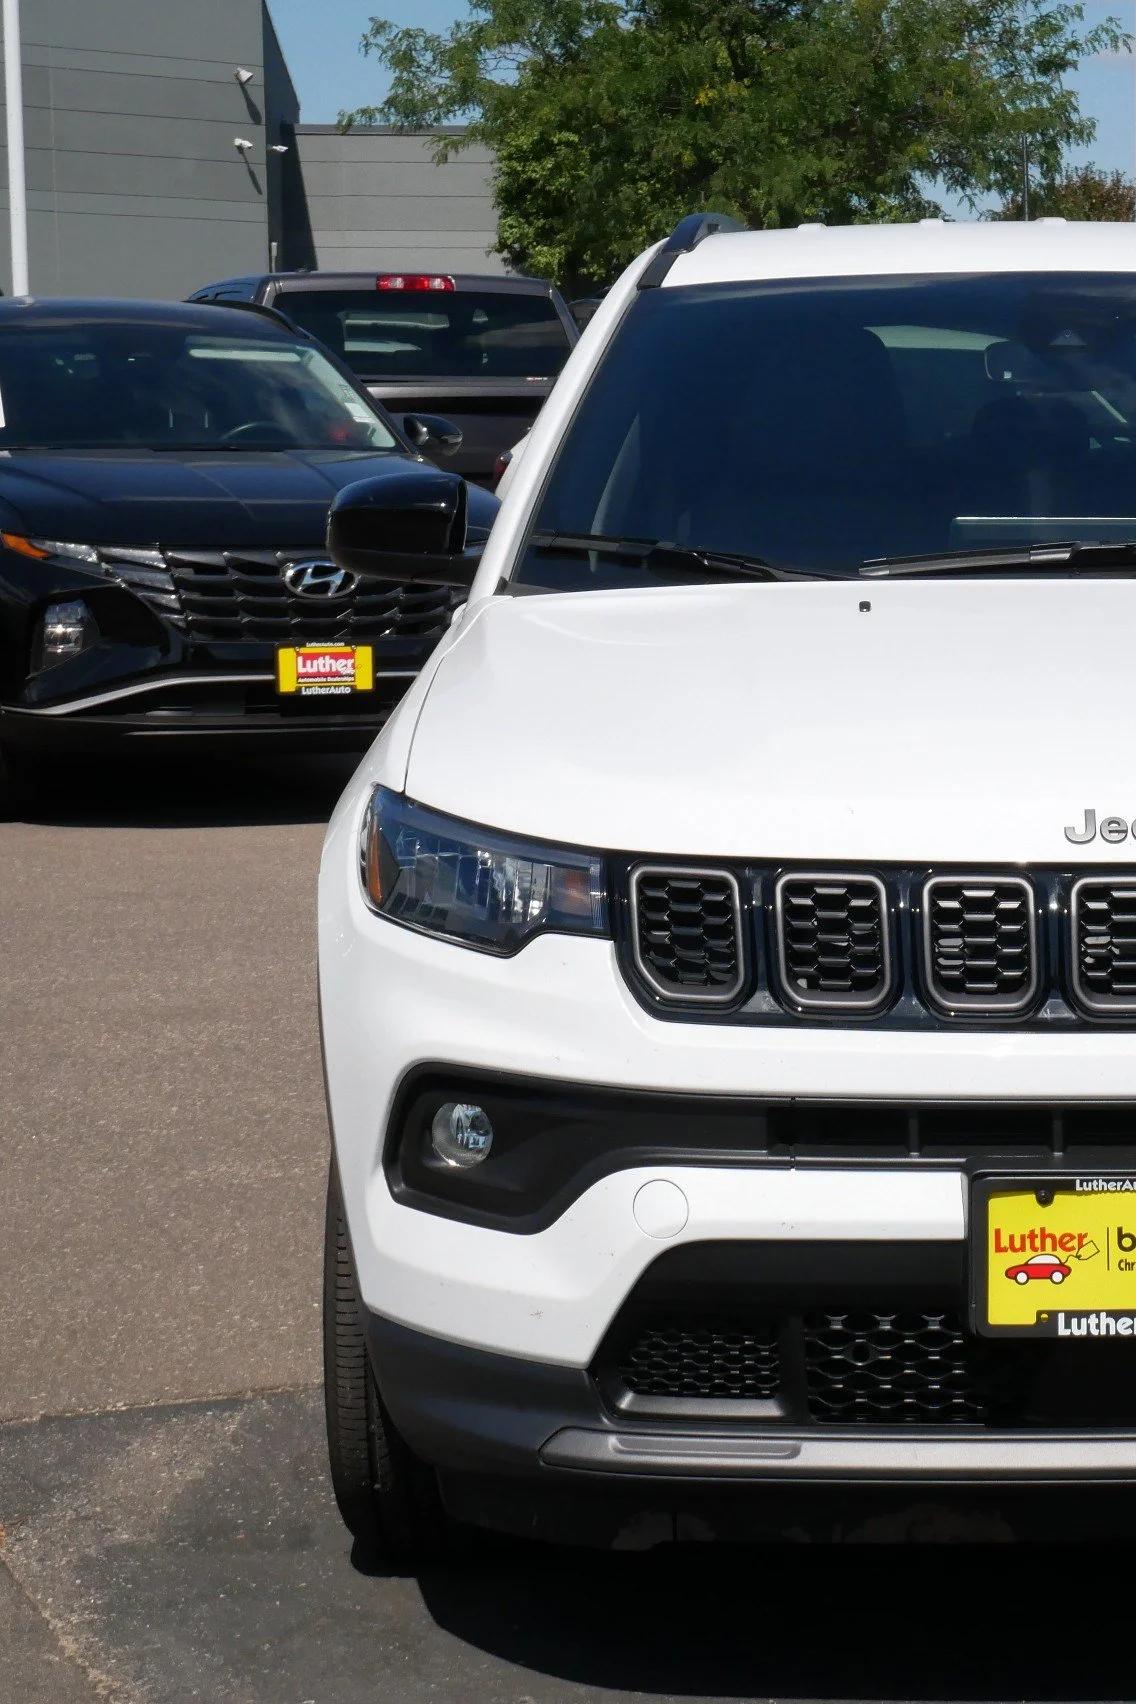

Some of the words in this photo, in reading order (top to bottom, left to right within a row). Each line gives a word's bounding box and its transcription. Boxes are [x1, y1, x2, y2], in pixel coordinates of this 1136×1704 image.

[297, 655, 354, 673] Luther
[301, 686, 351, 695] LutherAuto
[994, 1226, 1089, 1254] Luther
